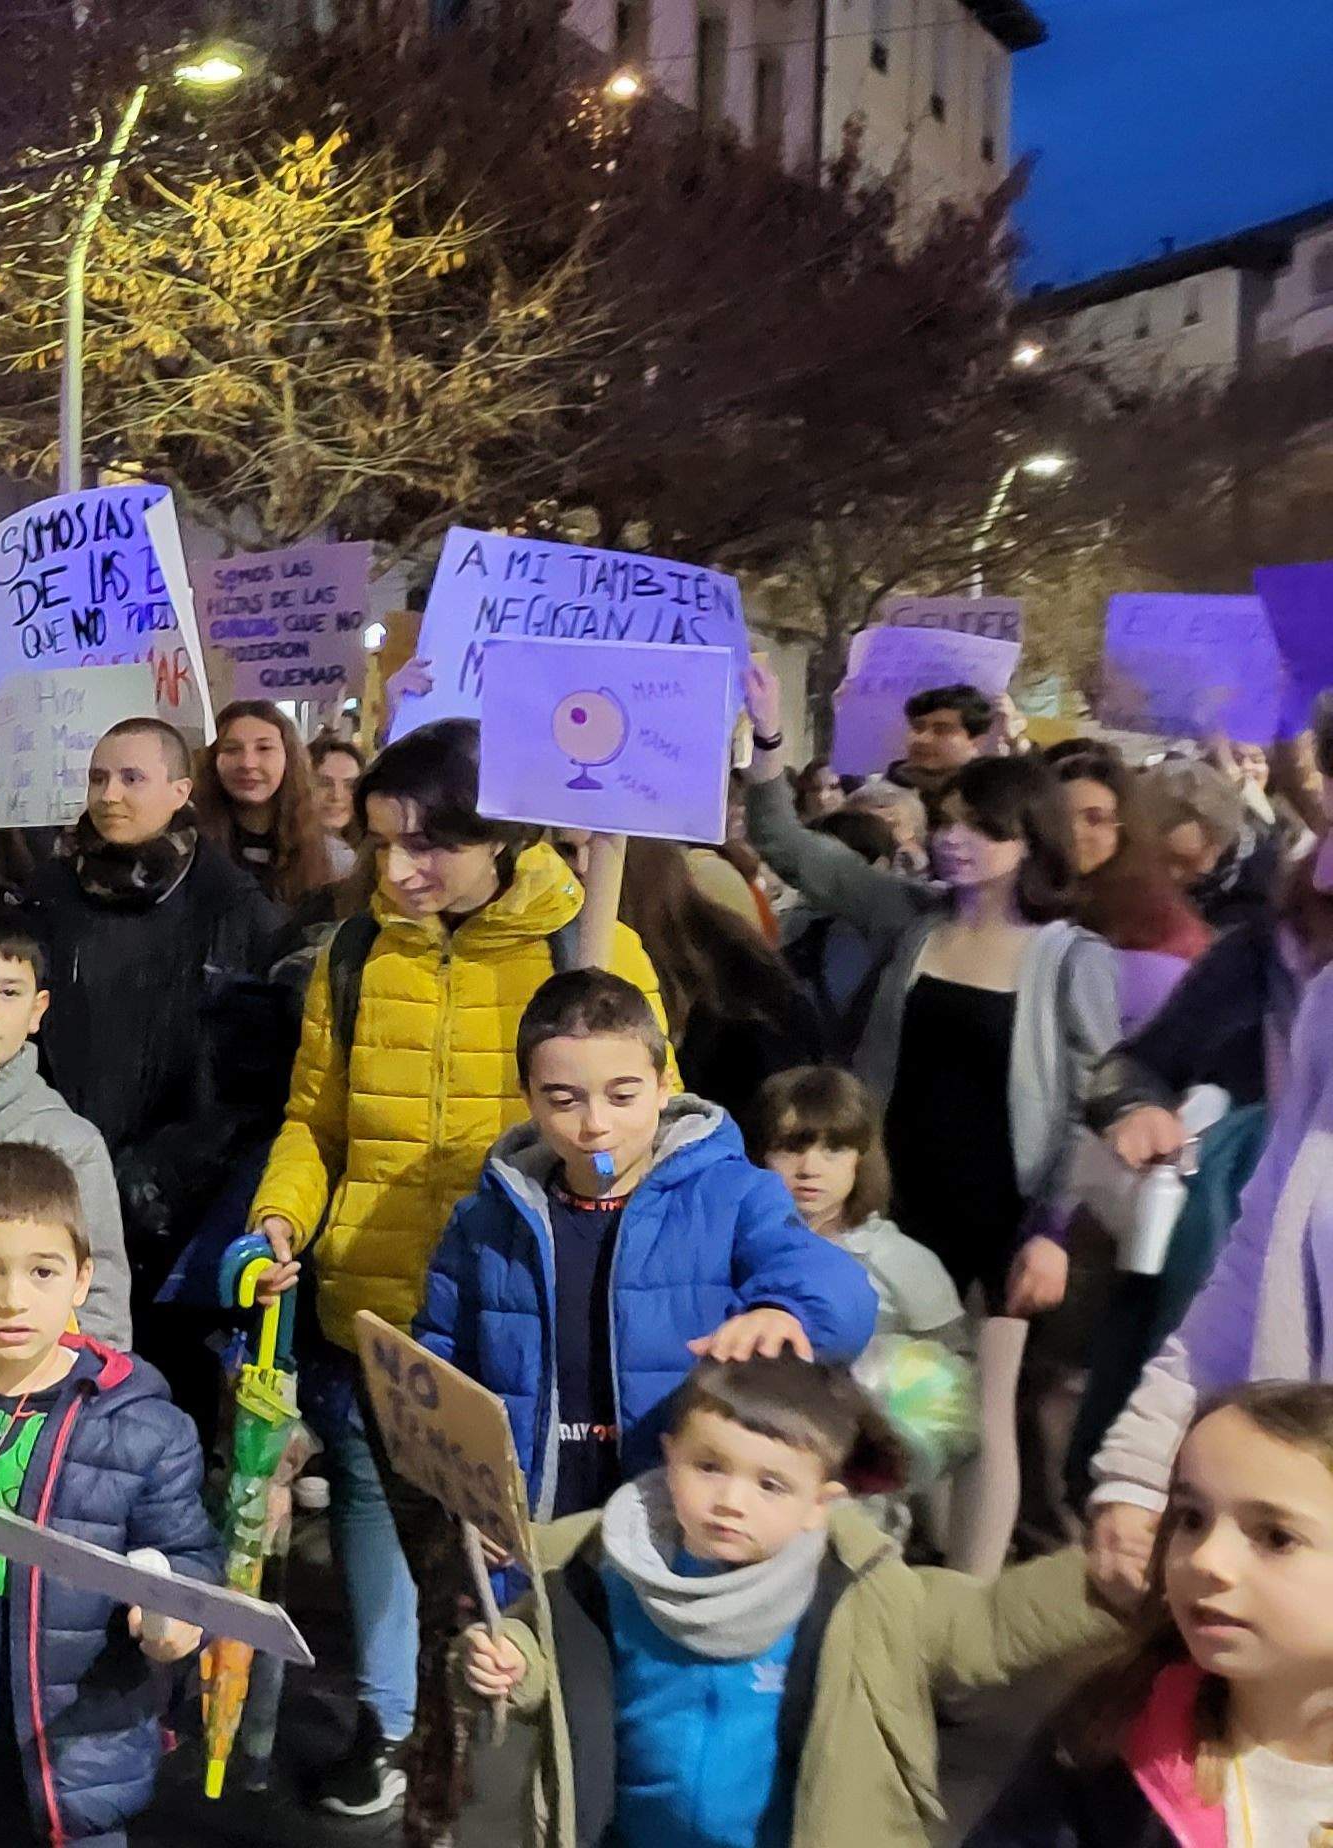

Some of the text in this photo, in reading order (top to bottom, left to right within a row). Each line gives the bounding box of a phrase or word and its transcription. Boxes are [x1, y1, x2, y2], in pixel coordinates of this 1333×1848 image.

[94, 498, 134, 542] LAS
[9, 565, 71, 626] DE
[90, 550, 130, 604] LAS
[214, 560, 314, 591] SOMOS LAS
[455, 540, 735, 620] A MI TAMBIEN
[270, 589, 297, 609] DE
[302, 586, 339, 605] LAS
[21, 618, 67, 660] QUE
[72, 607, 107, 649] NO
[284, 612, 328, 633] QUE
[336, 610, 364, 632] NO
[260, 664, 347, 688] QUEMAR
